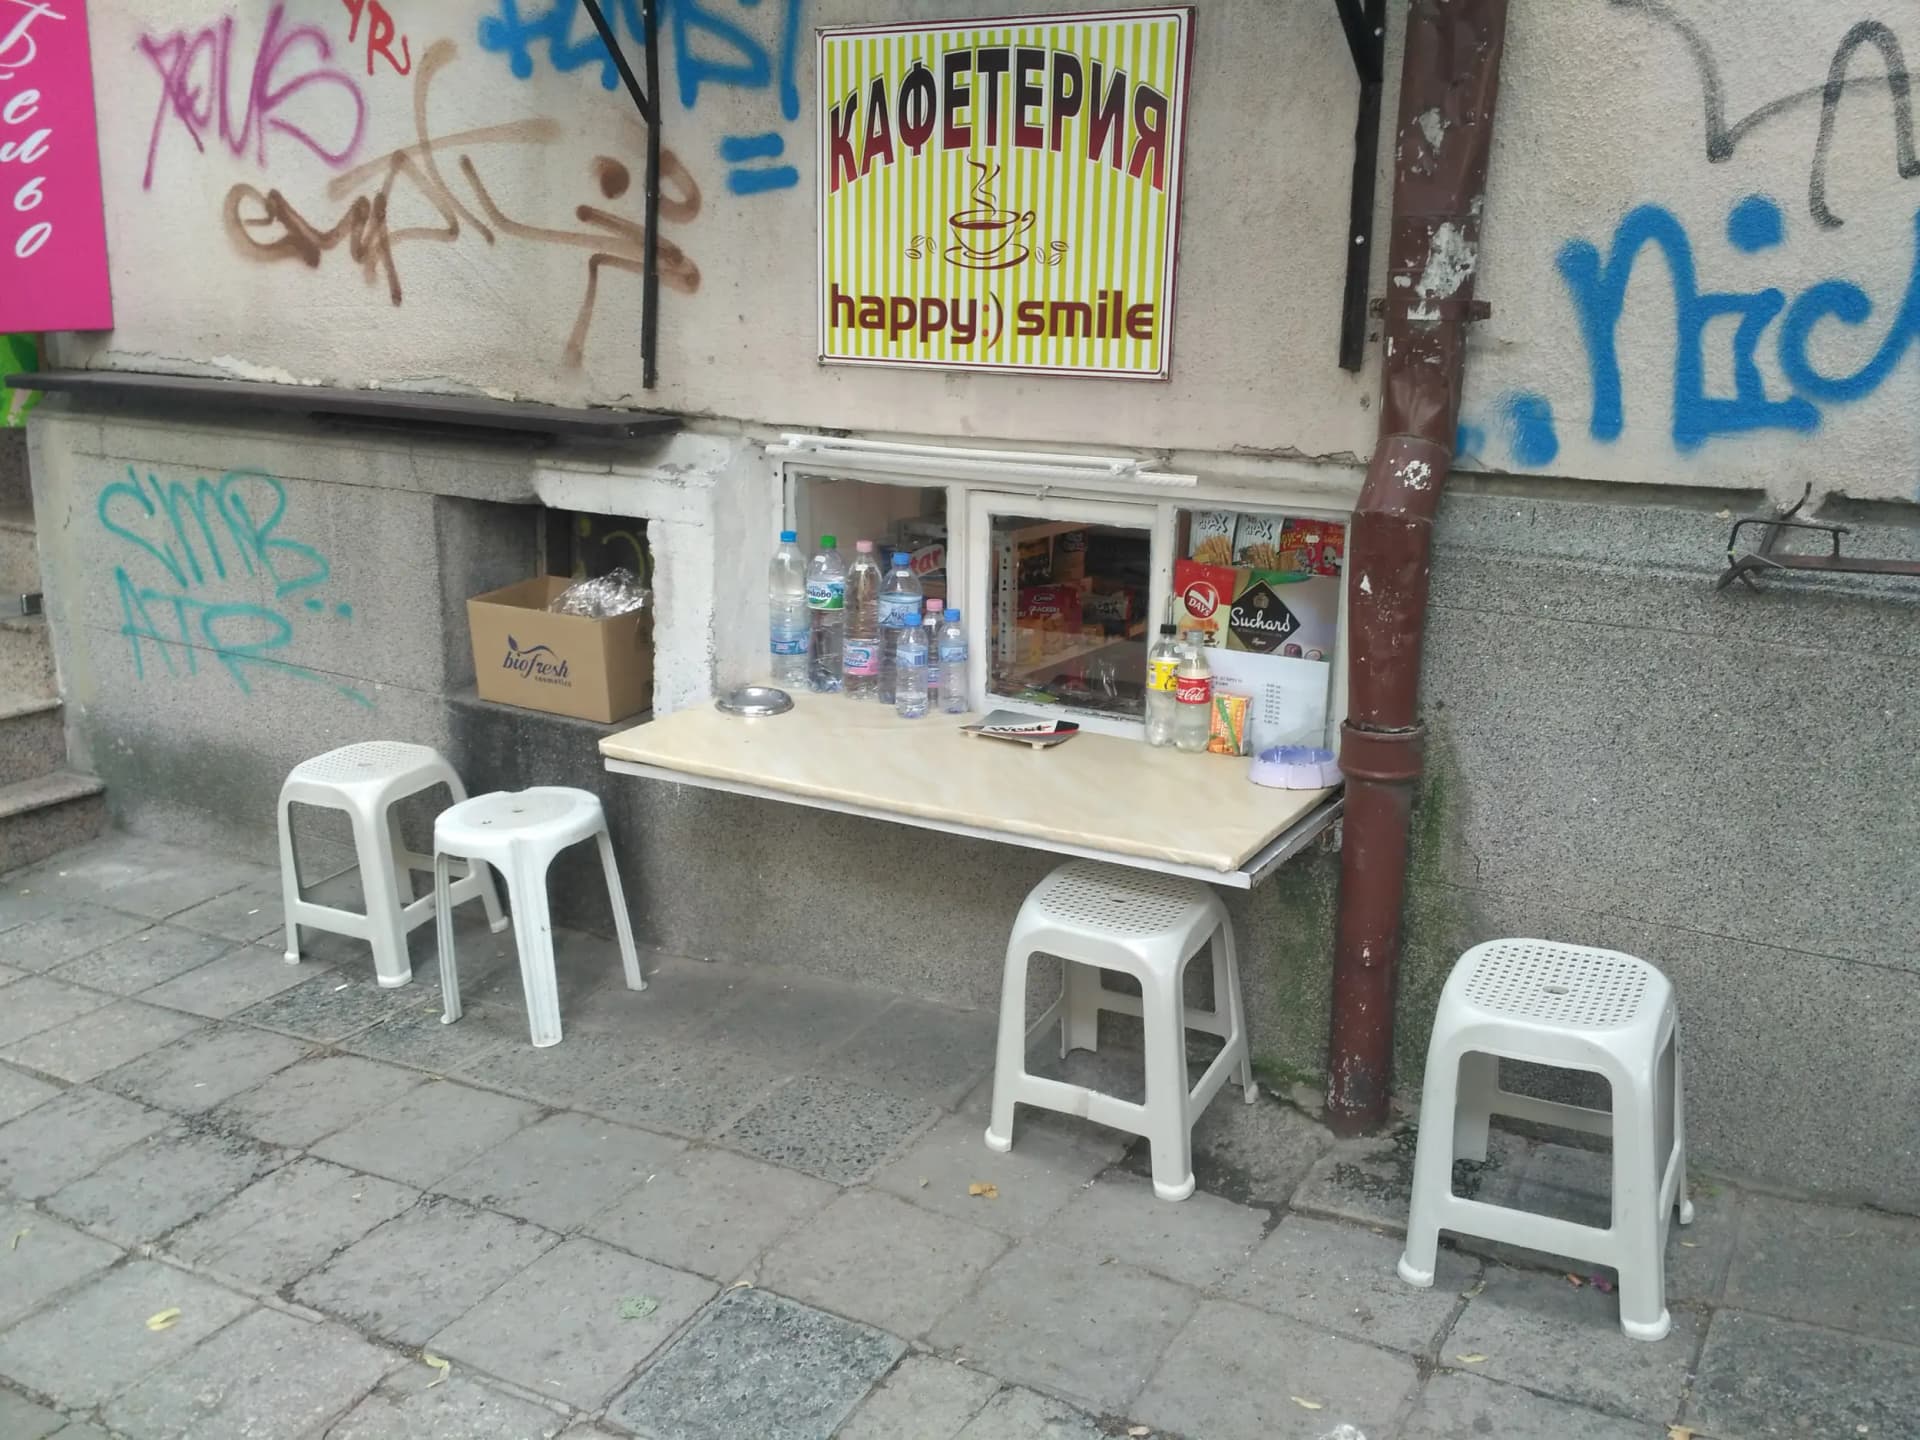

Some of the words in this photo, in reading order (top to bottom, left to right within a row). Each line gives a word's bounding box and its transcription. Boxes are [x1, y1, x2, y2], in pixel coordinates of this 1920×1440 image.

[829, 45, 1169, 194] КАФЕТЕРИЯ
[1017, 290, 1155, 341] smile
[1188, 588, 1215, 610] 7
[1188, 598, 1213, 617] DAYS
[1231, 607, 1290, 632] Suchard
[503, 650, 568, 679] biofresh
